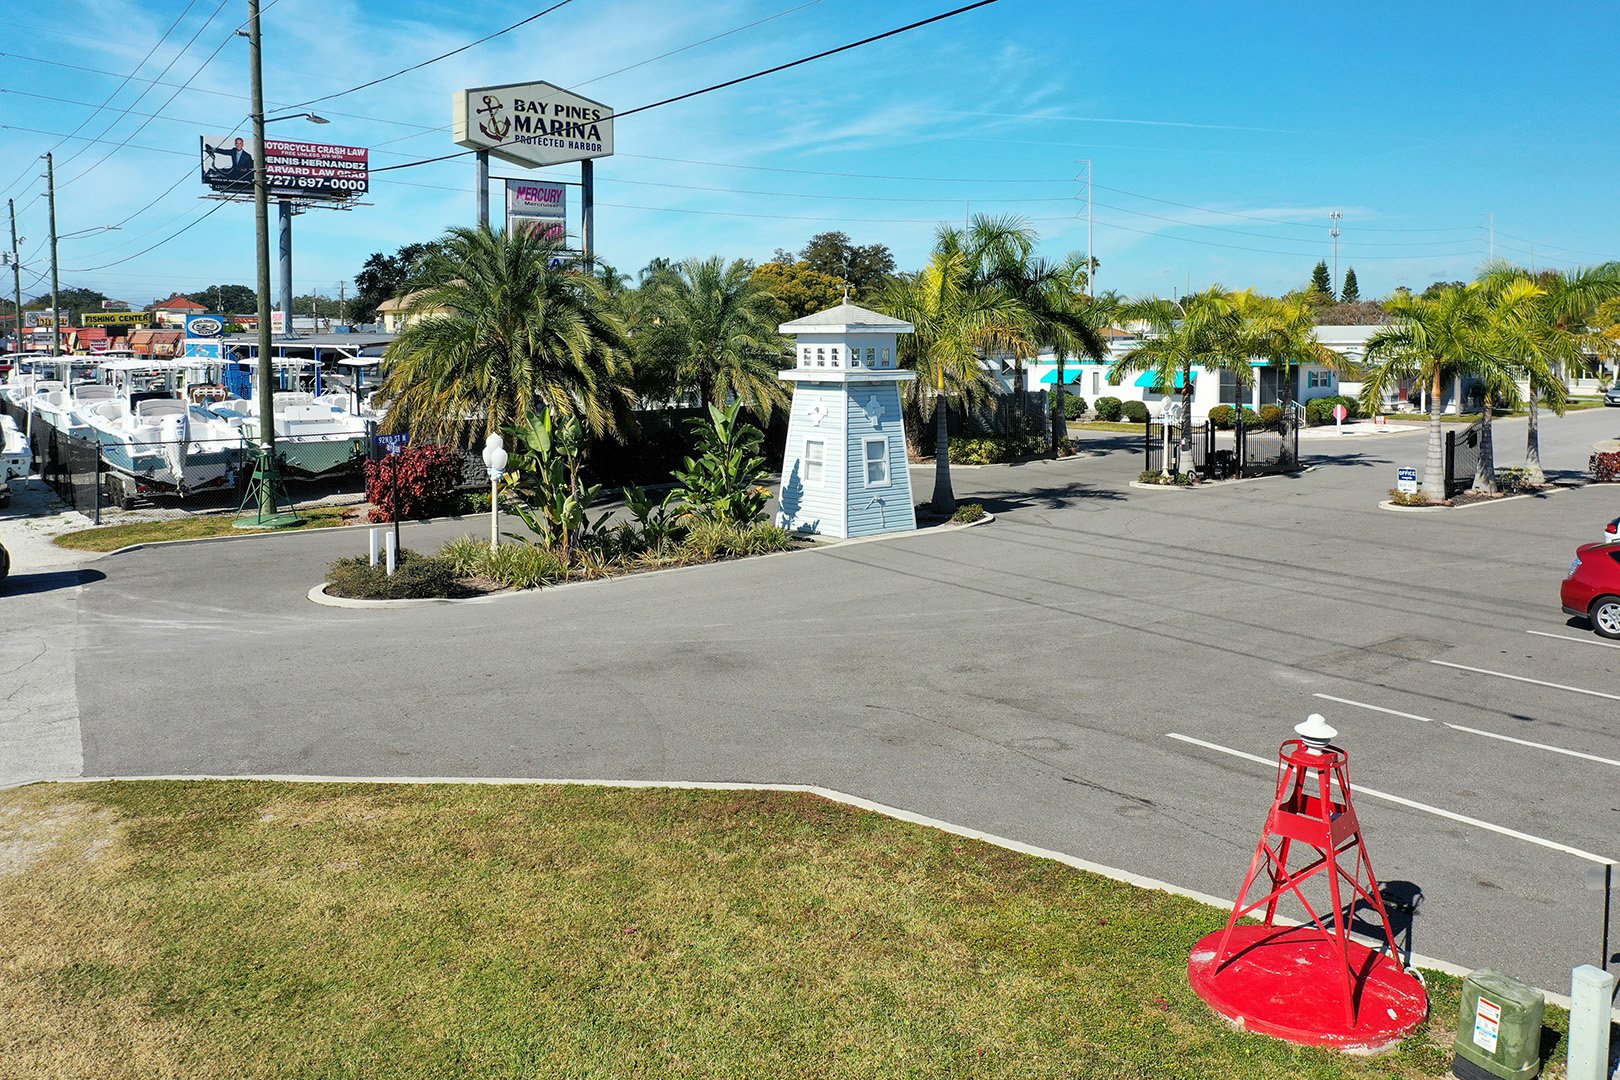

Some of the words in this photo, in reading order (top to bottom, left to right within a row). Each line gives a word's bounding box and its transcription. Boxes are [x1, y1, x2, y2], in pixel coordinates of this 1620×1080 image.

[514, 99, 548, 115] BAY
[554, 104, 601, 121] PINES
[514, 115, 602, 142] MARINA
[317, 146, 346, 155] CRASH
[347, 148, 366, 157] LAW
[515, 134, 565, 148] PROTECTED
[568, 140, 602, 152] HARBOR
[264, 156, 299, 166] ENNIS
[301, 158, 366, 170] HERNANDEZ
[265, 164, 310, 175] ARVARD
[312, 168, 335, 177] LAW
[336, 170, 366, 179] GRAD
[265, 174, 296, 187] 727)
[298, 176, 366, 191] 697-0000
[516, 186, 563, 203] MERCURY
[85, 315, 116, 323] FISHING
[119, 314, 148, 322] CENTER
